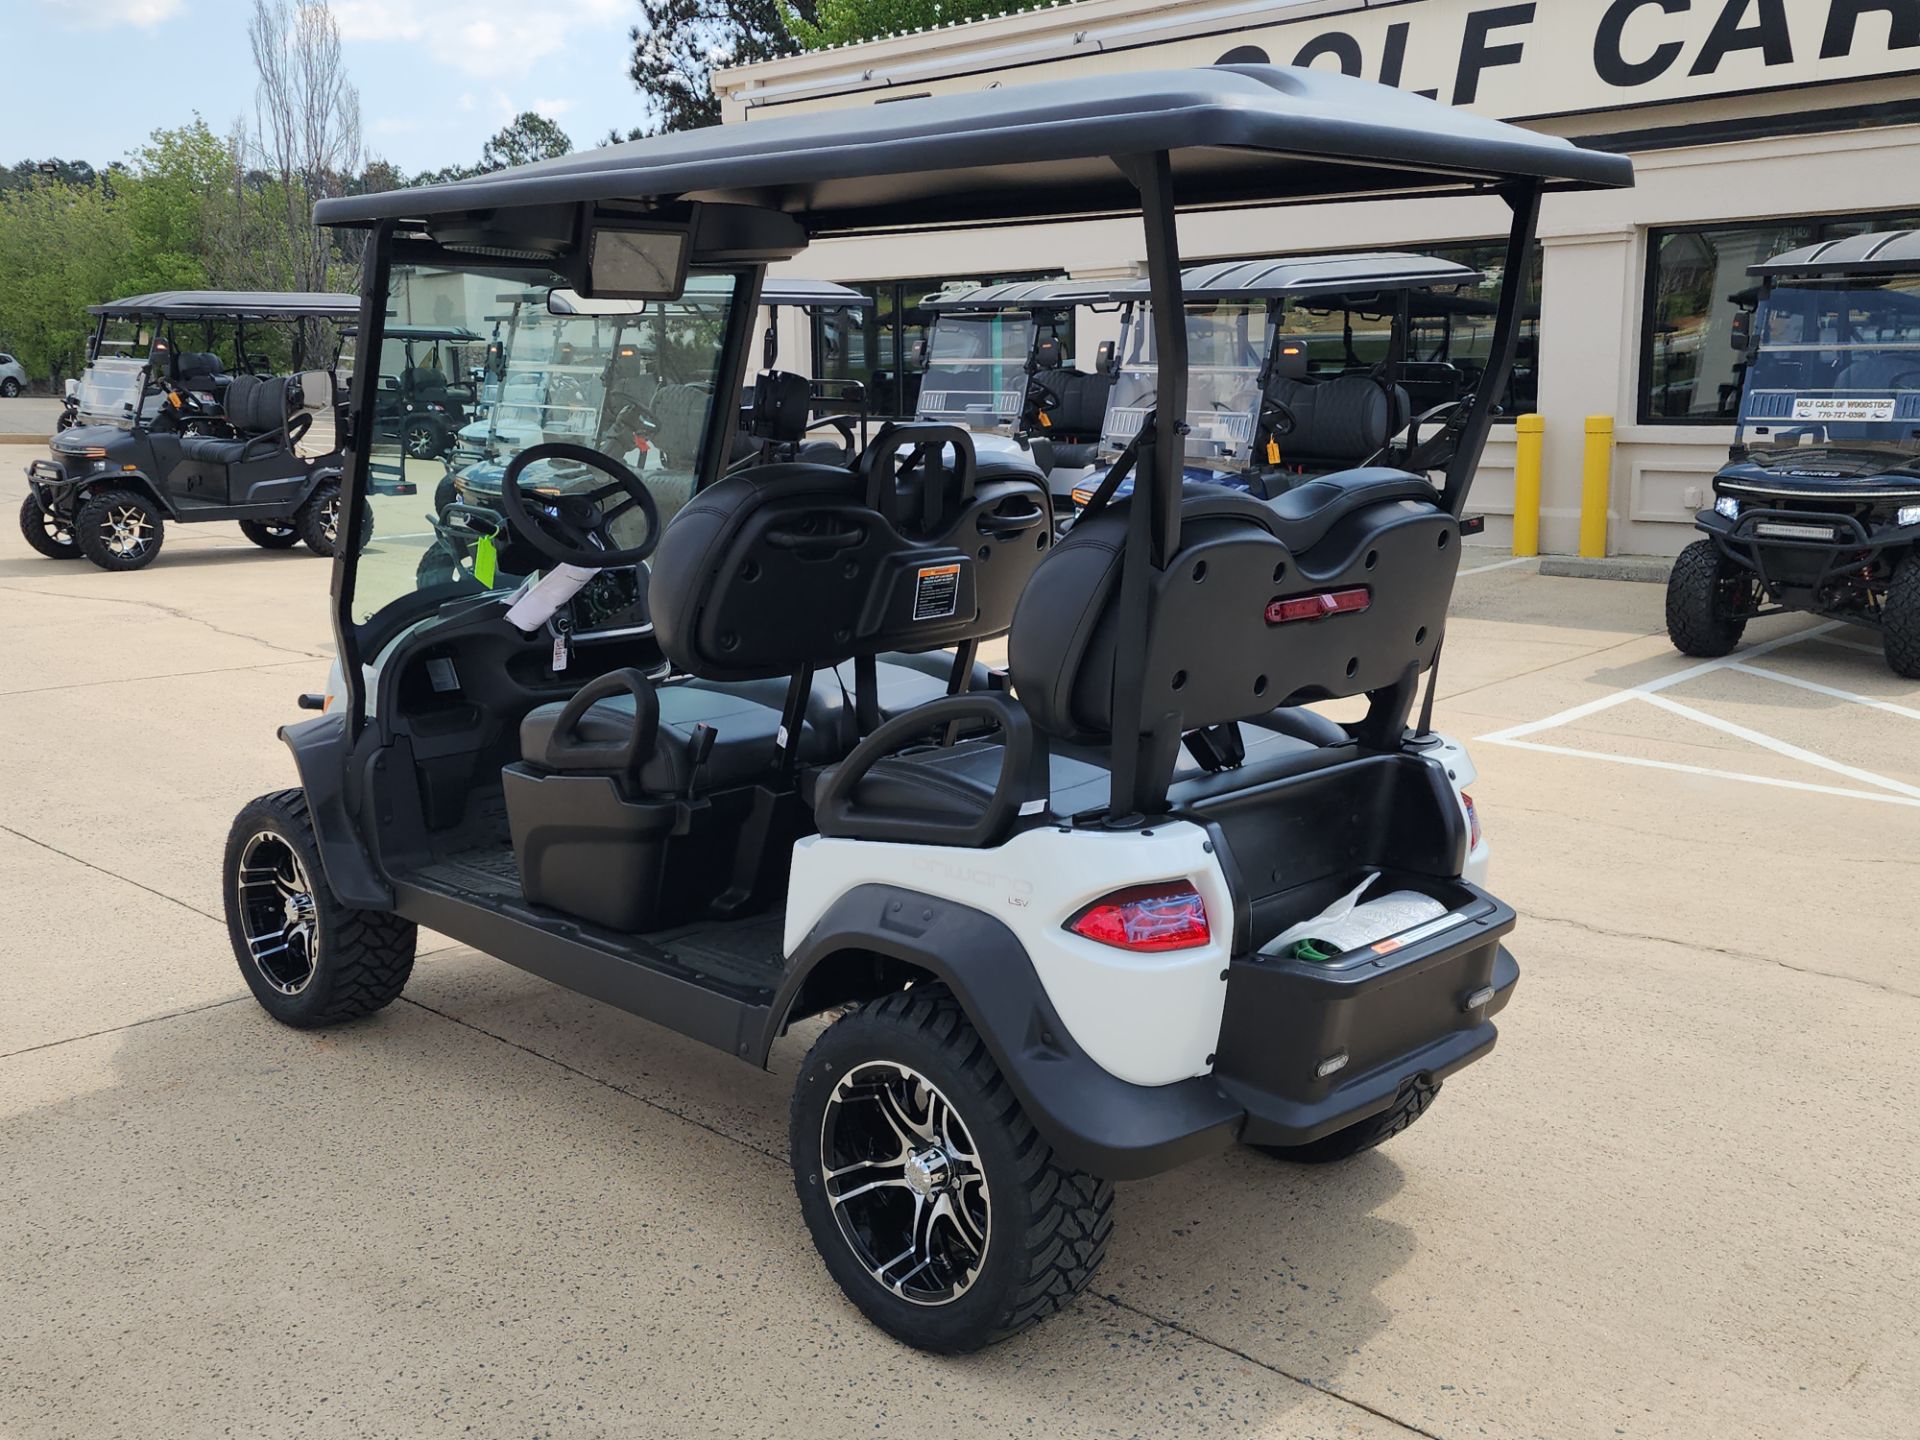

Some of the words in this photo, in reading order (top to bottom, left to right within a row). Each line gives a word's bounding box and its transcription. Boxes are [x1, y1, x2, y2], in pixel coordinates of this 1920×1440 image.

[1212, 2, 1537, 107] LF
[1815, 401, 1834, 409] CARS
[1836, 401, 1846, 409] OF
[1847, 401, 1893, 409] WOODSTOCK
[1007, 896, 1030, 908] LSV
